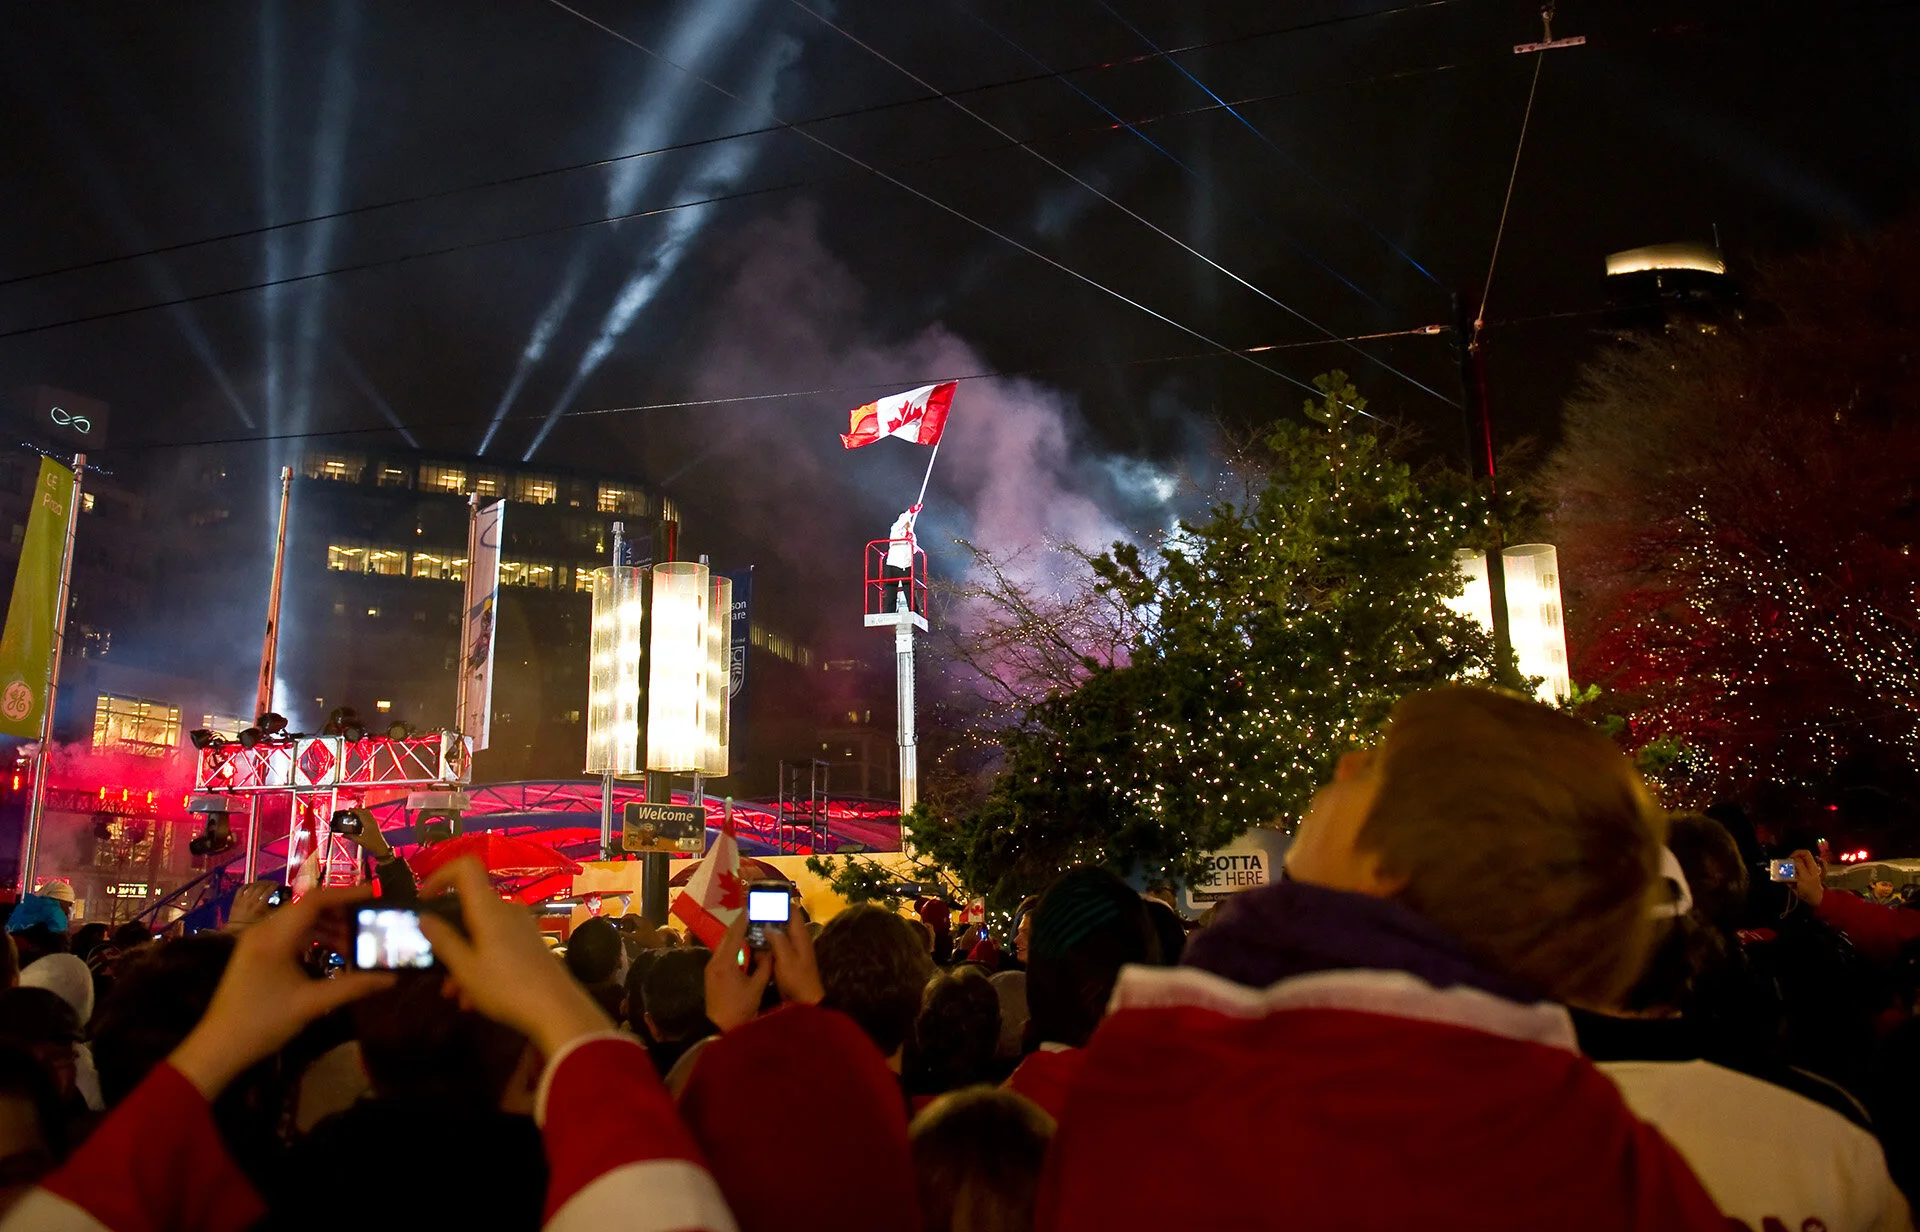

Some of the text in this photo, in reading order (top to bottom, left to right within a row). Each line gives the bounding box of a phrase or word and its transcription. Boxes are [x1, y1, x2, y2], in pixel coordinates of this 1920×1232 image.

[639, 806, 695, 822] Welcome
[1205, 855, 1262, 871] GOTTA
[1226, 870, 1263, 886] HERE
